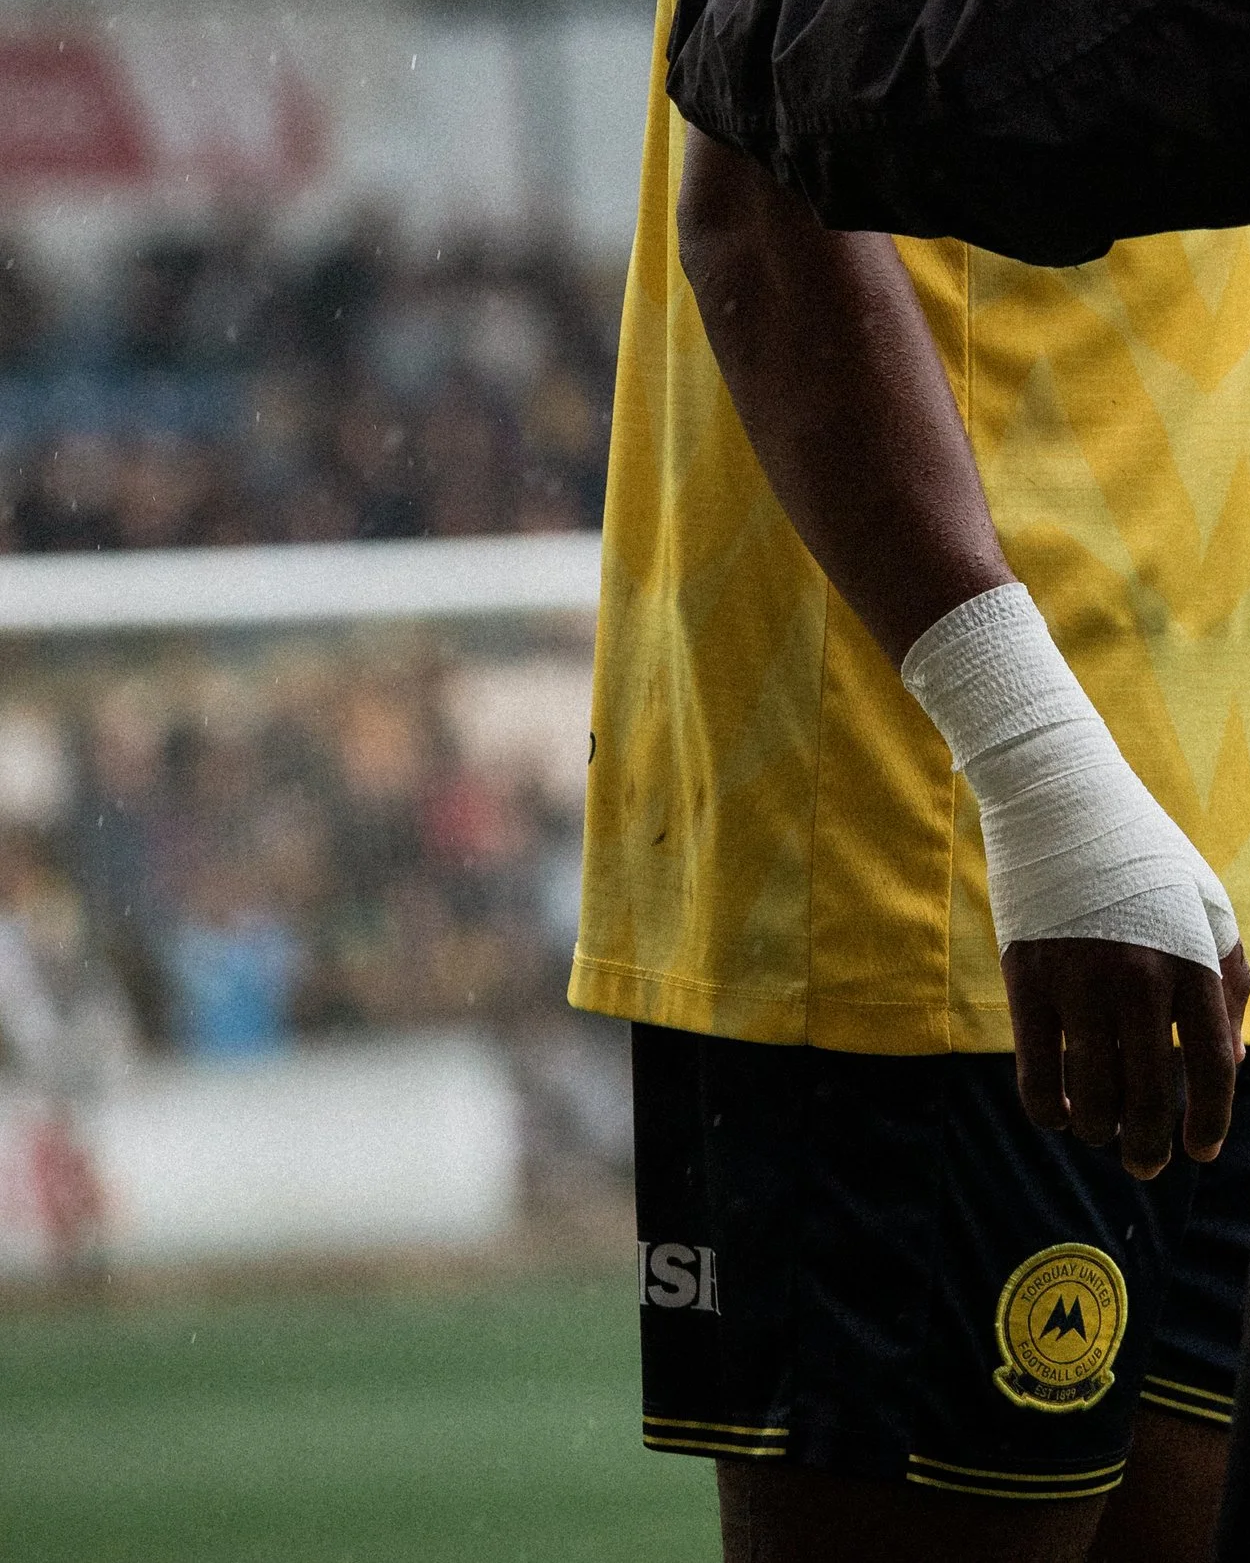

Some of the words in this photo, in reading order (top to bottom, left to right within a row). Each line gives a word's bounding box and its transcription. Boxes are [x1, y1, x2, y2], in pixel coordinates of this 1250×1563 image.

[1020, 1263, 1078, 1304] TORQUAY
[1079, 1266, 1111, 1308] UNITED
[1017, 1340, 1071, 1382] FOOTBALL
[1074, 1346, 1103, 1378] CLUB
[1033, 1384, 1054, 1400] EST
[1055, 1387, 1077, 1401] 1899
